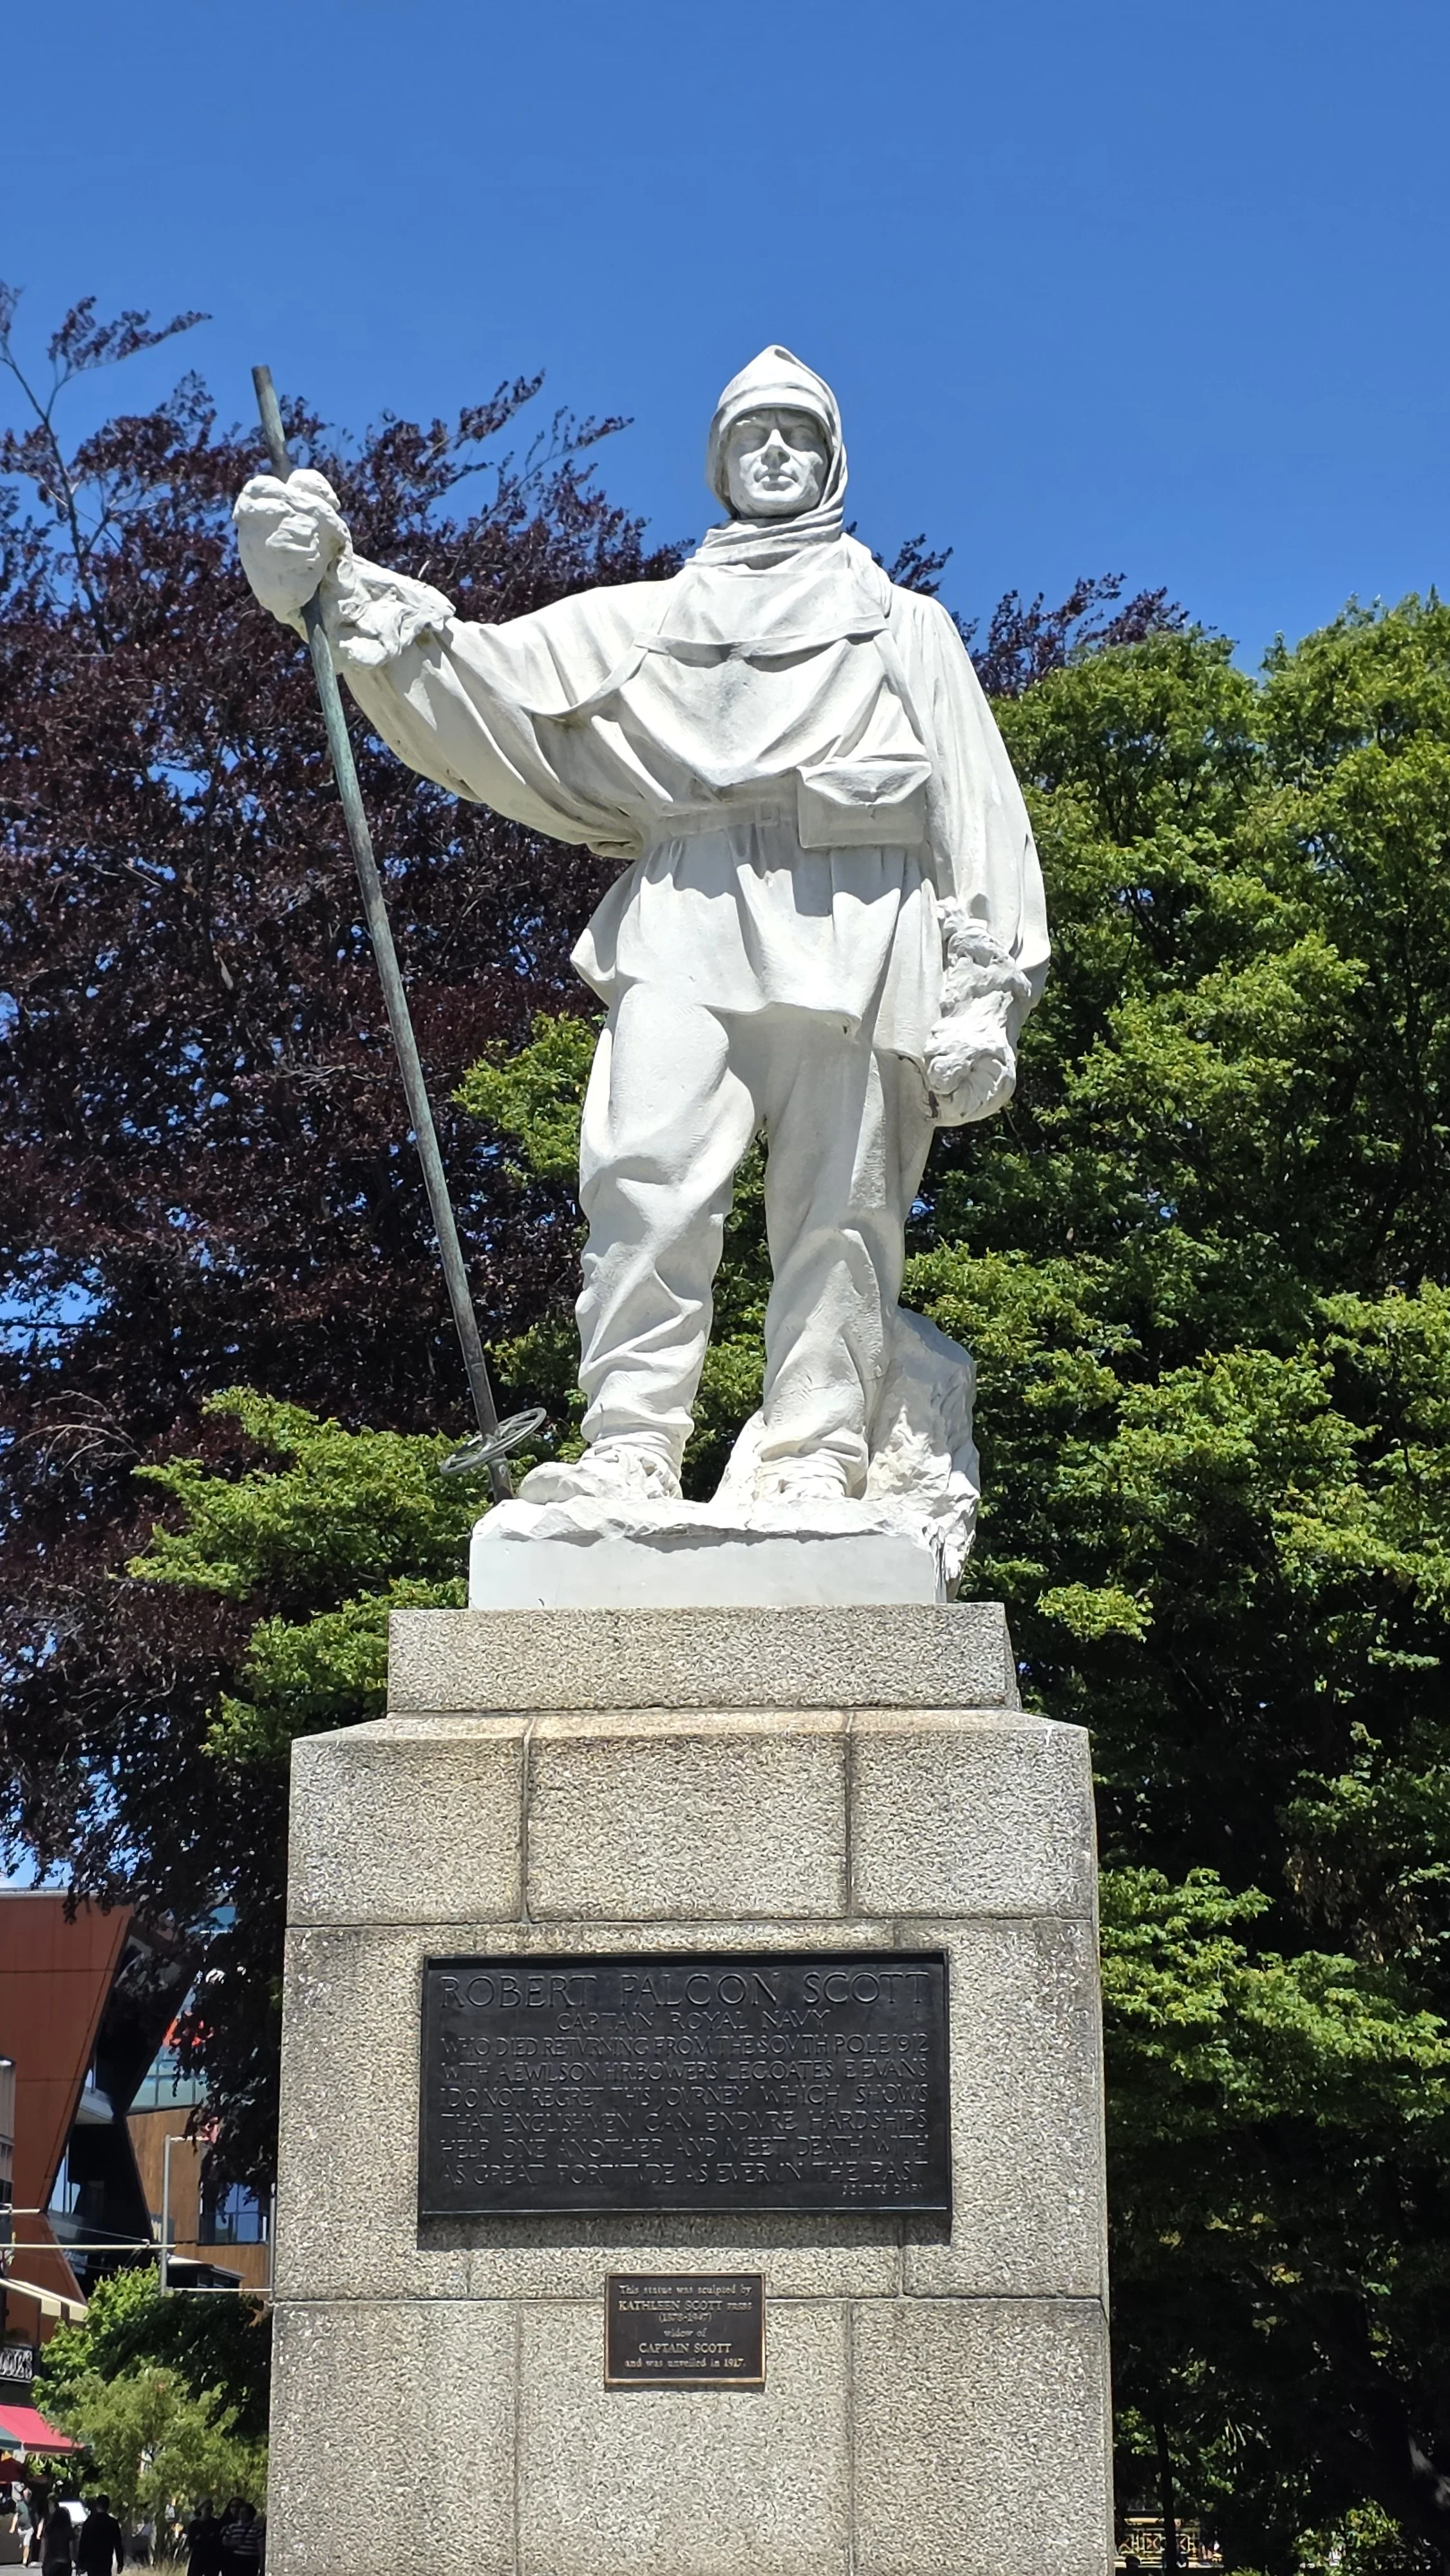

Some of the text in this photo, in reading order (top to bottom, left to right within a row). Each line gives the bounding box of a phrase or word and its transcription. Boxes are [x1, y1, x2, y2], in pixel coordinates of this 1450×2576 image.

[438, 1971, 929, 2008] ROBERT FALCON SCOTT
[557, 2009, 831, 2031] CAPTAIN ROYAL NAVY
[440, 2037, 491, 2056] WHO
[496, 2036, 538, 2056] DIED
[654, 2036, 713, 2056] FROM
[714, 2035, 755, 2055] THE
[834, 2034, 892, 2055] POLE
[892, 2033, 929, 2054] 1912
[440, 2061, 491, 2083] WITH
[449, 2087, 480, 2108] DO
[483, 2087, 526, 2107] NOT
[531, 2087, 605, 2107] REGRET
[610, 2086, 652, 2107] THIS
[759, 2084, 840, 2106] WHICH
[854, 2083, 928, 2105] SHOWS
[440, 2113, 494, 2134] THAT
[502, 2112, 632, 2133] ENGLISHMEN
[645, 2112, 693, 2132] CAN
[808, 2109, 928, 2130] HARDSHIPS
[439, 2134, 929, 2159] HELP ONE ANOTHER AND MEET DEATH WITH
[439, 2164, 467, 2185] AS
[473, 2163, 545, 2185] GREAT
[684, 2163, 709, 2184] AS
[717, 2162, 770, 2184] EVER
[811, 2161, 861, 2182] THE
[871, 2160, 929, 2181] PAST
[619, 2284, 752, 2297] This statue was sculpted by
[619, 2300, 681, 2311] KATHLEEN
[684, 2300, 722, 2311] SCOTT
[663, 2327, 707, 2338] widow of
[638, 2343, 732, 2354] CAPTAIN SCOTT
[625, 2357, 643, 2367] and
[667, 2357, 707, 2367] unveiled
[710, 2358, 720, 2367] in
